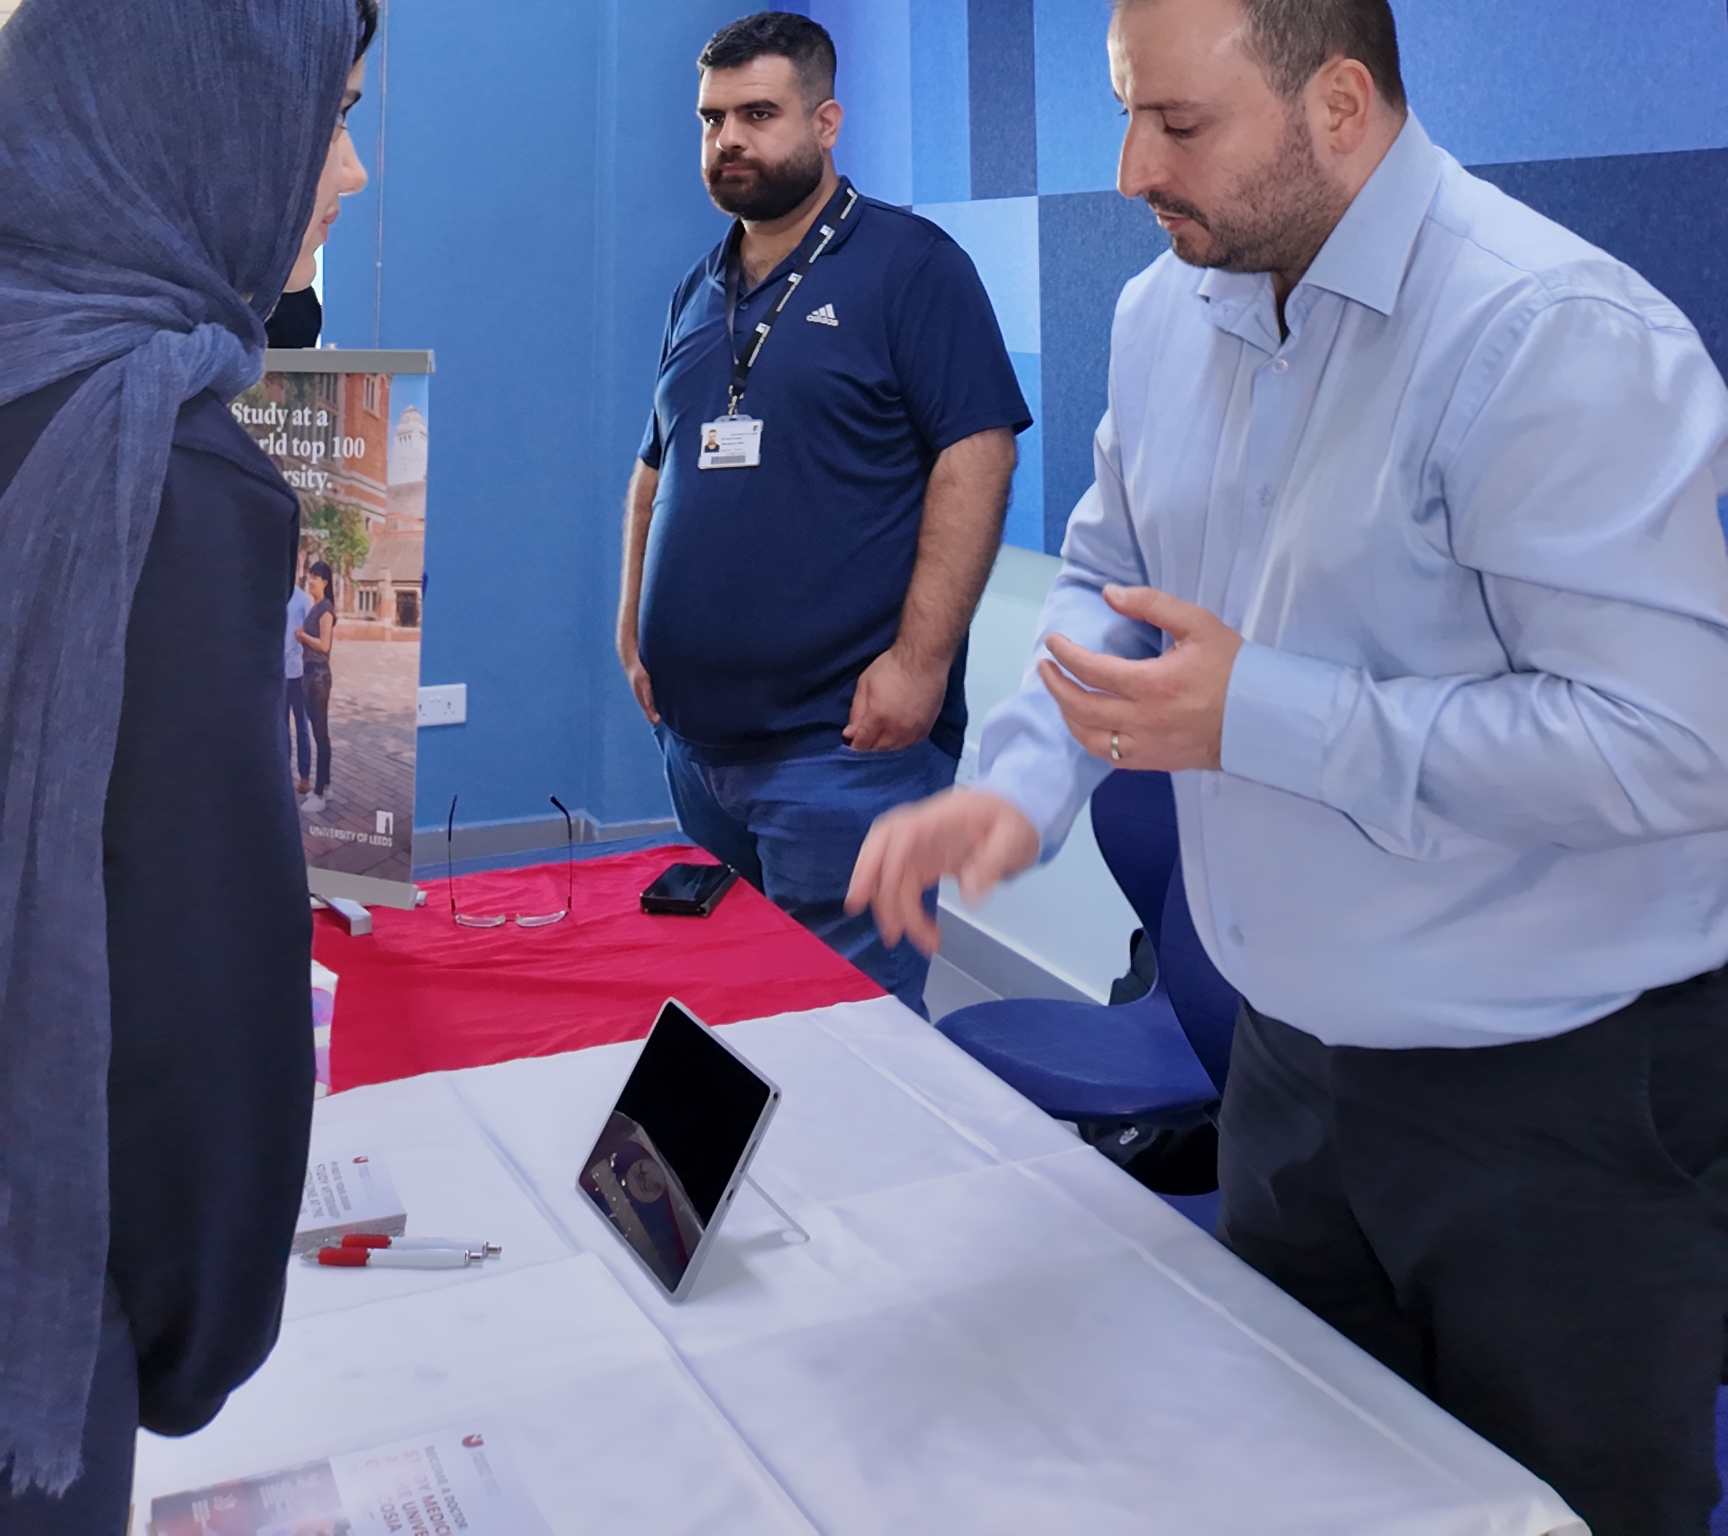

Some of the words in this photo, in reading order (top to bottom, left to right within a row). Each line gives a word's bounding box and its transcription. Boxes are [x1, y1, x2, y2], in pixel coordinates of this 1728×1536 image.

[231, 402, 289, 432] Study
[292, 406, 312, 426] at
[316, 409, 329, 426] a
[258, 432, 287, 456] rld
[292, 438, 325, 464] top
[332, 436, 366, 458] 100
[282, 464, 332, 495] rsity.
[309, 826, 356, 841] UNIVERSITY
[357, 833, 368, 843] OF
[369, 835, 393, 847] LEEDS
[441, 1487, 451, 1495] A
